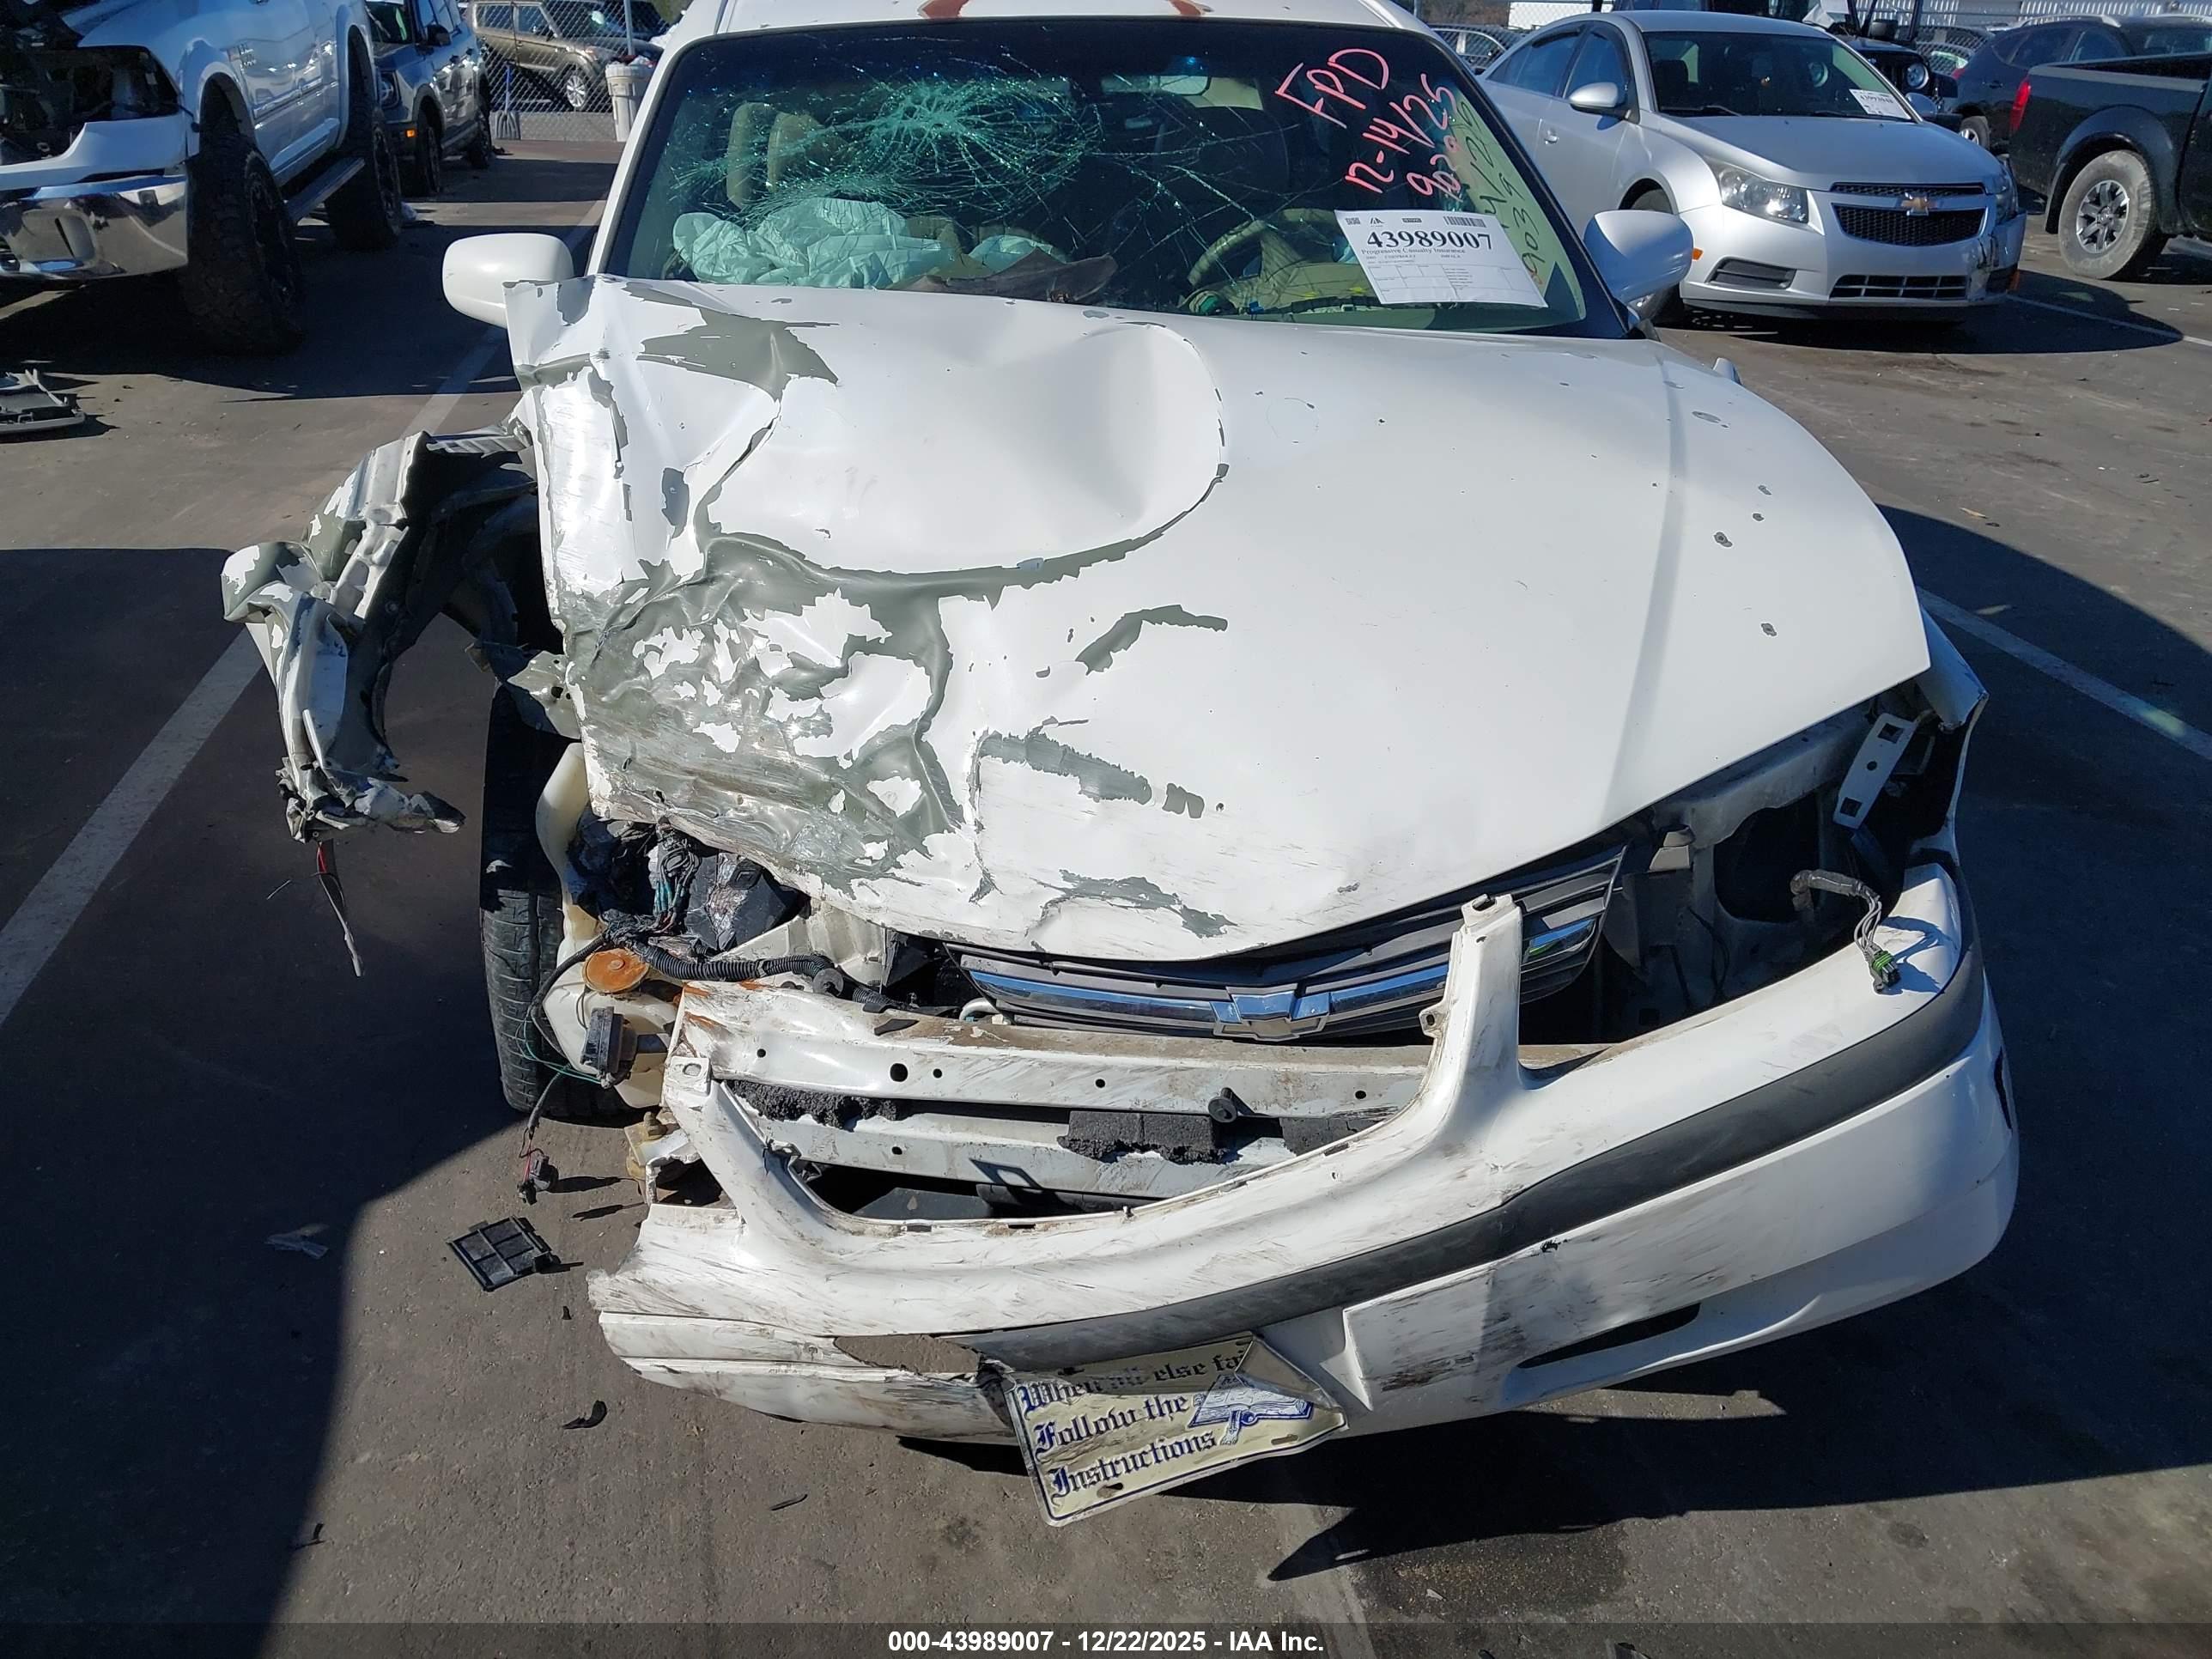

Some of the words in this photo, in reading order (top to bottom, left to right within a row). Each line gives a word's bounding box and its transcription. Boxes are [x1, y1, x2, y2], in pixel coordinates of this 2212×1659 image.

[1274, 48, 1389, 129] FPD
[1367, 230, 1492, 250] 43989007
[1016, 1379, 1103, 1419] When
[1153, 1363, 1206, 1382] else
[1033, 1407, 1136, 1462] Follow
[1143, 1394, 1189, 1421] the
[1048, 1431, 1217, 1507] Instructions
